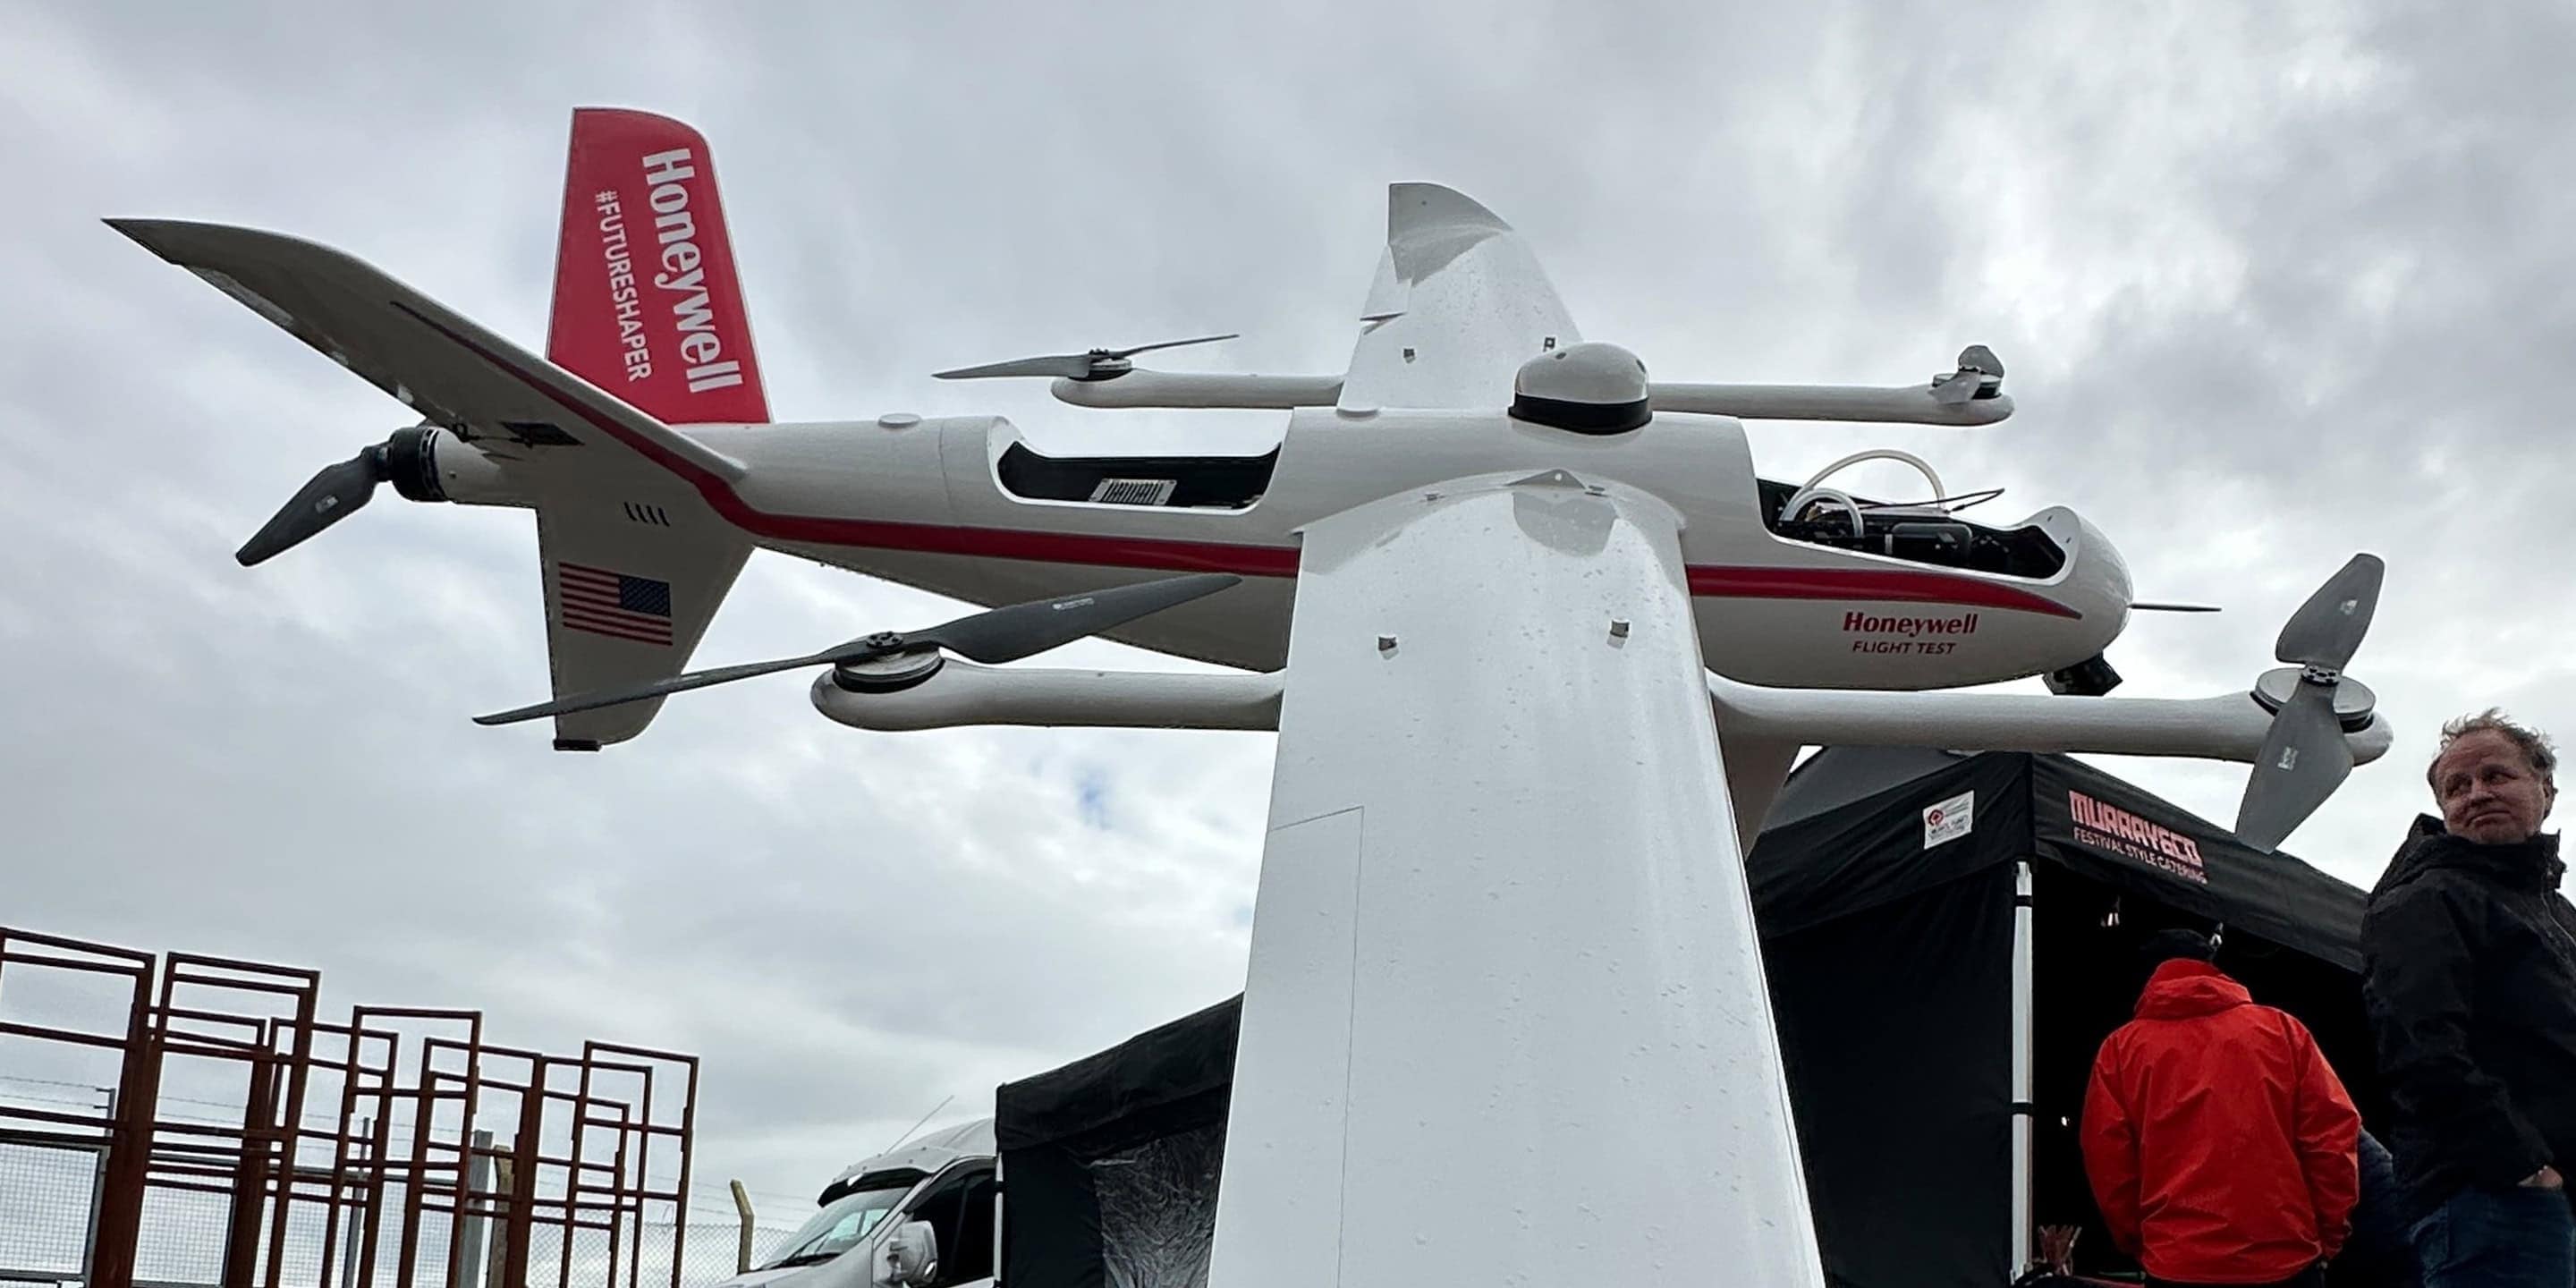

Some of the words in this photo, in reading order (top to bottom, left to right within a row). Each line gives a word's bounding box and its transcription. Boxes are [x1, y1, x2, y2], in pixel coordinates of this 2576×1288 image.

[595, 190, 652, 382] #FUTURESHAPER
[642, 148, 743, 393] Honeywell
[1843, 611, 1979, 638] Honeywell
[1852, 640, 1912, 654] FLIGHT
[1917, 642, 1956, 655] TEST
[2073, 826, 2126, 855] FESTIVAL
[2125, 843, 2157, 867] STYLE
